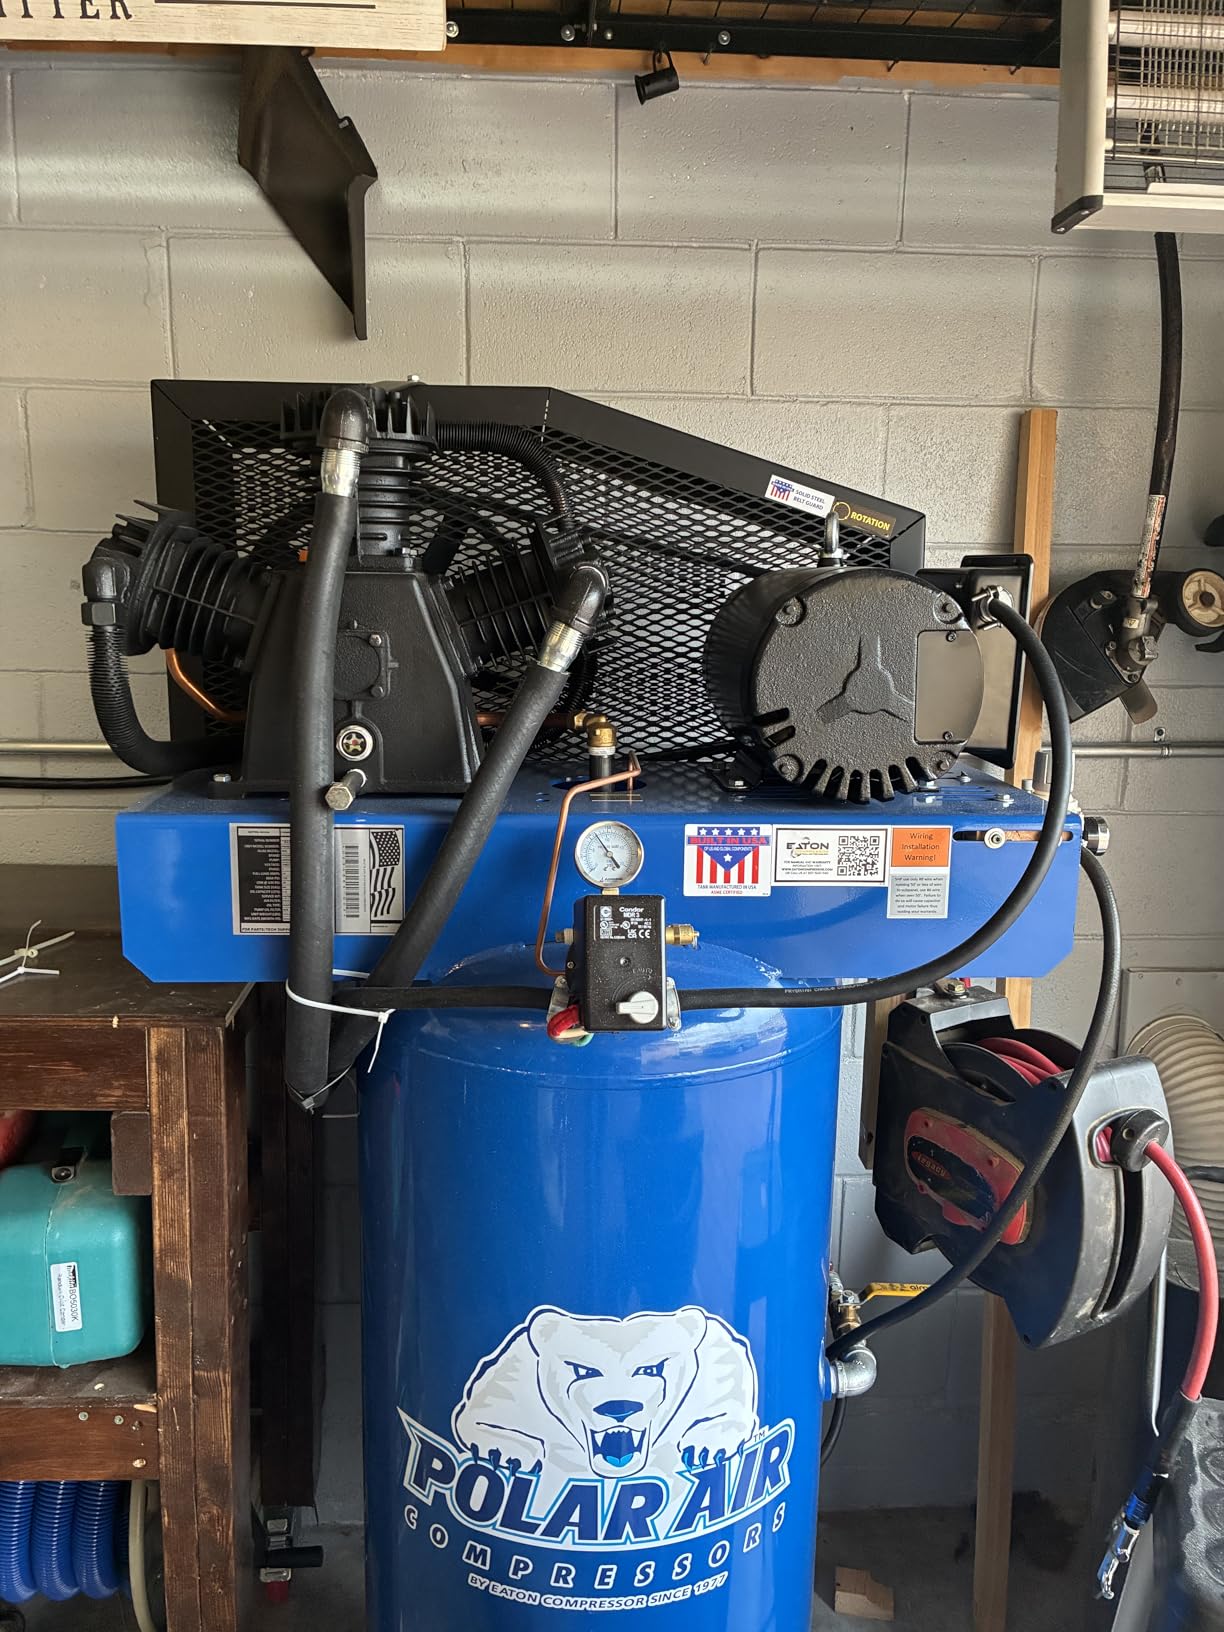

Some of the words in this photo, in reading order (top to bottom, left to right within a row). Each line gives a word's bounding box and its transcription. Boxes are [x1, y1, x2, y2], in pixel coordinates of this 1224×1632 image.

[795, 489, 811, 499] SOLID
[805, 501, 824, 510] GUARD
[850, 511, 891, 531] ROTATION
[689, 836, 723, 845] BUILT
[726, 836, 739, 845] IN
[742, 836, 768, 845] USA
[910, 832, 934, 841] Wiring
[786, 842, 830, 850] EATON
[904, 854, 936, 862] Warning!
[405, 1423, 667, 1544] POLAR
[672, 1419, 794, 1538] AIR
[404, 1501, 787, 1589] COMPRESSORS
[469, 1574, 488, 1589] BY
[491, 1583, 539, 1603] EATON
[542, 1596, 646, 1611] COMPRESSOR
[649, 1587, 690, 1605] SINCE
[694, 1573, 729, 1594] 1977
